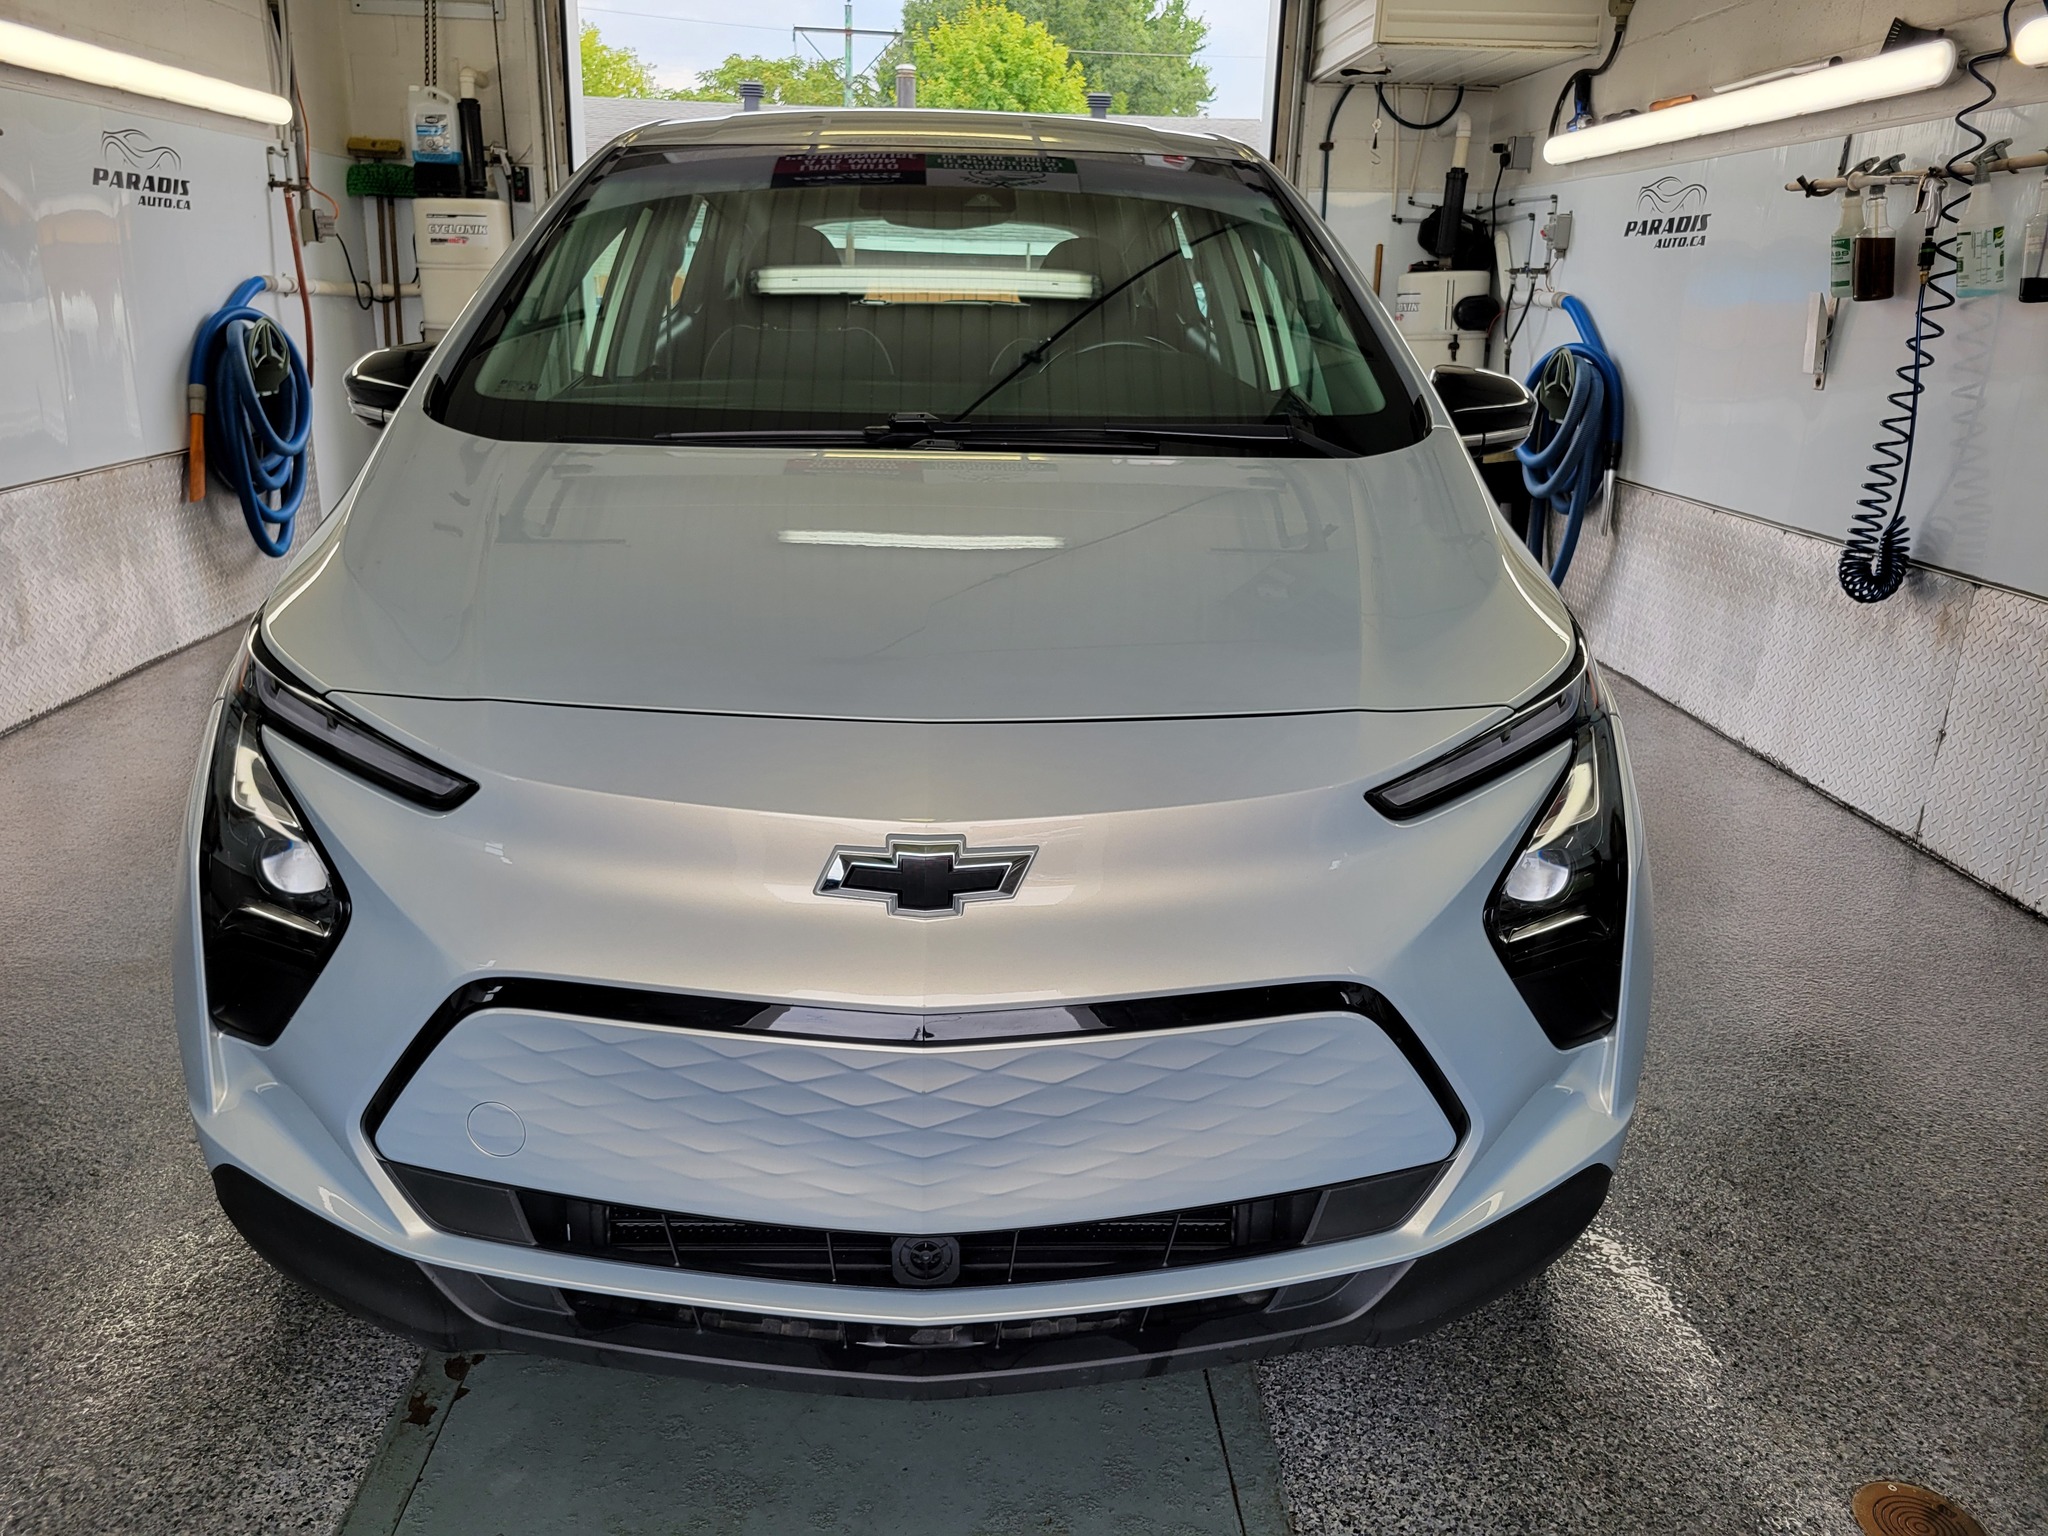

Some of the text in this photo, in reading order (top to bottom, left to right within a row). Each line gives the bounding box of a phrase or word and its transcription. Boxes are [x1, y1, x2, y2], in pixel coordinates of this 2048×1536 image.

[92, 167, 190, 196] PARADIS
[138, 195, 191, 210] AUTO.CA
[428, 223, 488, 235] CYCLONIK
[1624, 213, 1712, 238] PARADIS
[1653, 235, 1707, 249] AUTO.CA
